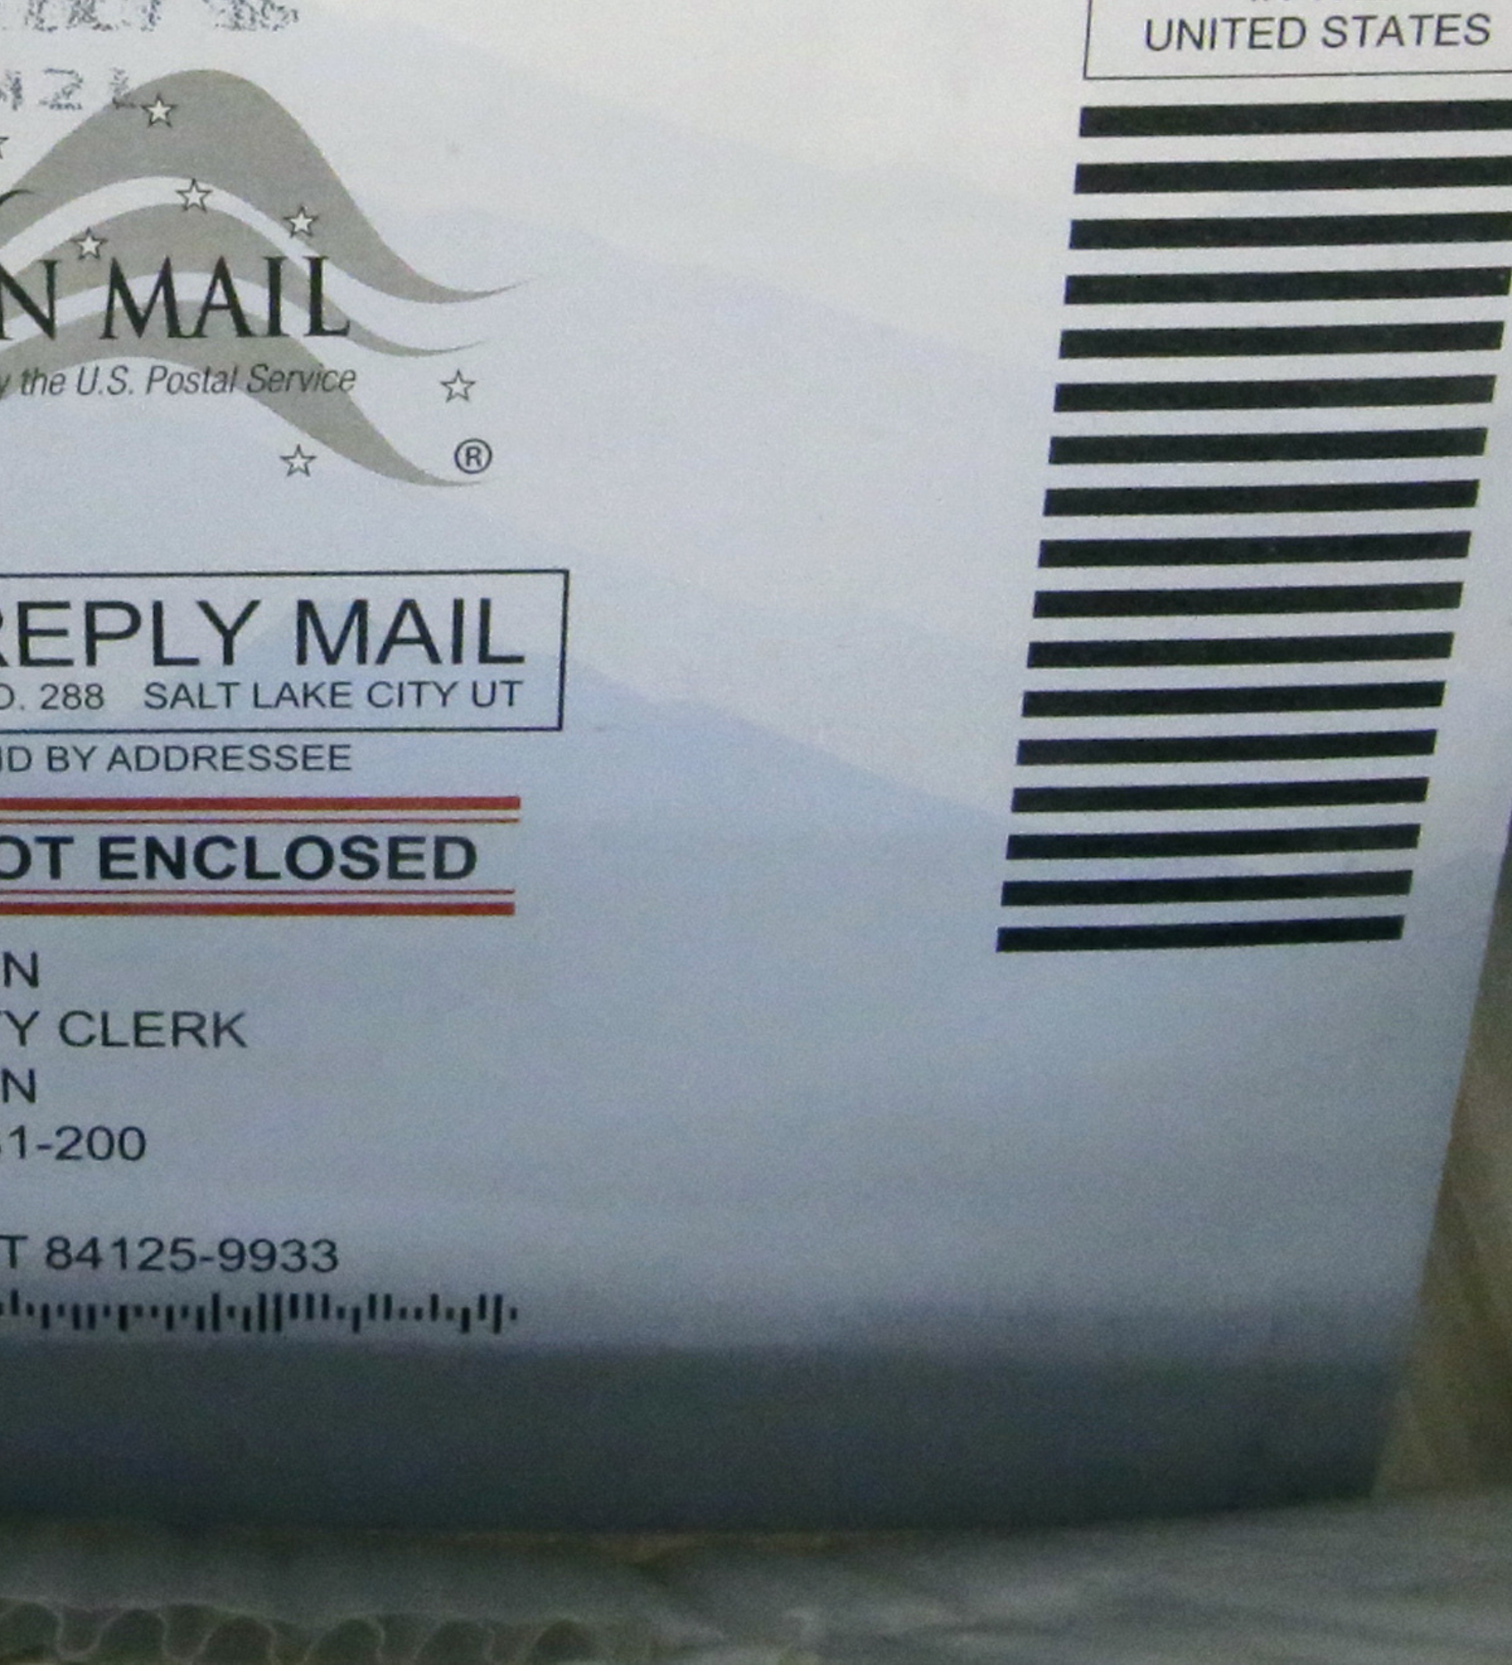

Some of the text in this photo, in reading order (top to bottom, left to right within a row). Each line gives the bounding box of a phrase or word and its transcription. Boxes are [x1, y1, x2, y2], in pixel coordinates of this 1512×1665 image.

[1145, 12, 1491, 52] UNITED STATES
[98, 255, 352, 339] MAIL
[20, 366, 68, 396] the
[76, 364, 136, 396] U.S.
[144, 364, 237, 394] Postal
[247, 362, 357, 394] Service
[295, 597, 526, 667] MAIL
[39, 682, 105, 711] 288
[144, 681, 241, 711] SALT
[252, 680, 352, 710] LAKE
[366, 680, 459, 709] CITY
[471, 679, 524, 709] UT
[46, 745, 97, 773] BY
[106, 743, 352, 773] ADDRESSEE
[98, 834, 477, 882] ENCLOSED
[58, 1009, 247, 1049] CLERK
[44, 1235, 340, 1275] 84125-9933
